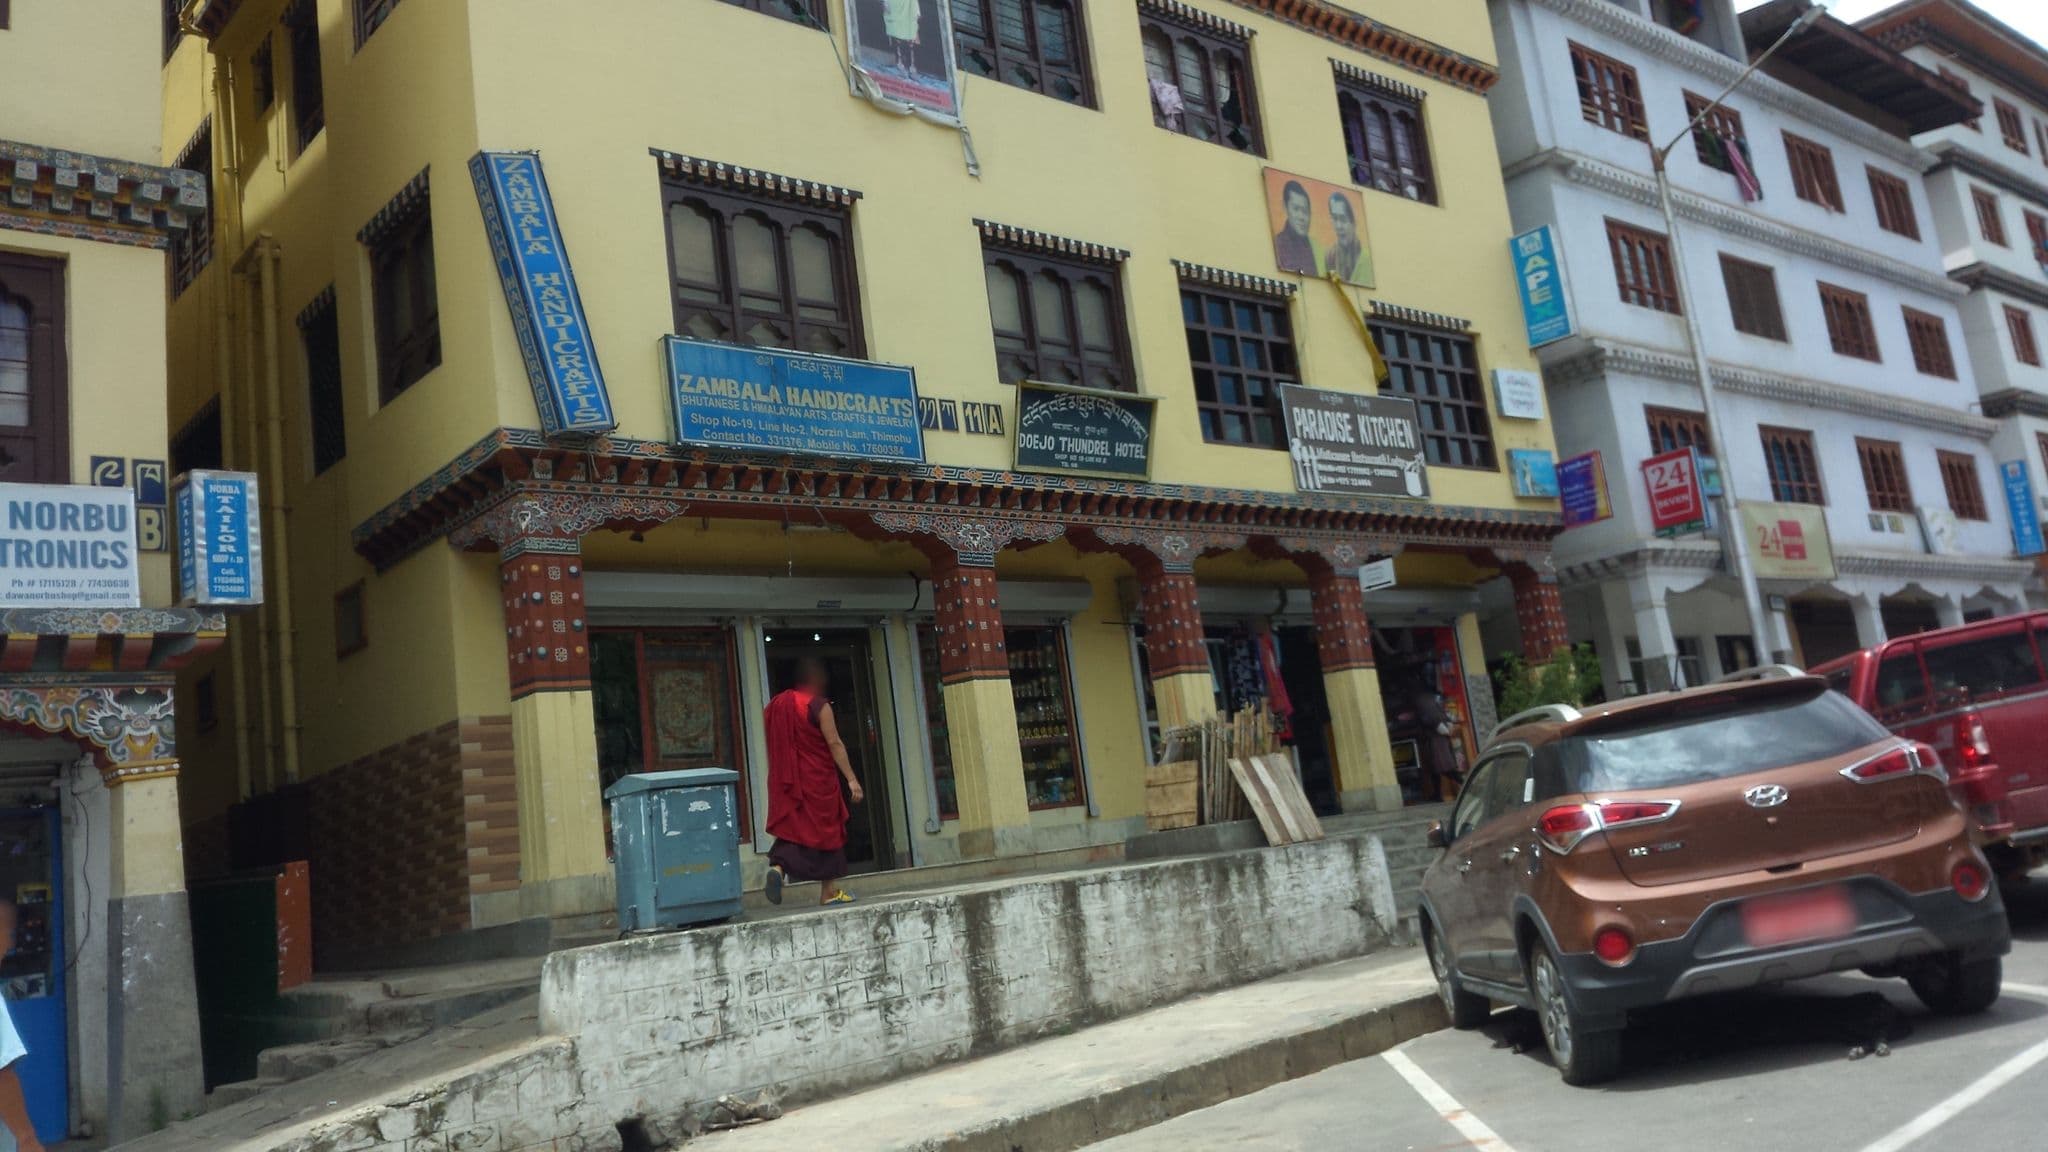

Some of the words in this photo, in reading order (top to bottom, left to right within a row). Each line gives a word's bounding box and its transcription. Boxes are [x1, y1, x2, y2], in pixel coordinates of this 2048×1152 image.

[500, 159, 551, 255] ZAMBALA
[533, 272, 602, 425] HANDICRAFTS
[1523, 255, 1558, 321] APEX
[680, 374, 783, 404] ZAMBALA
[786, 386, 913, 418] HANDICRAFTS
[682, 395, 740, 411] BHUTANESE
[752, 402, 801, 418] HIMALAYAN
[831, 411, 866, 424] CRAFTS
[877, 417, 914, 429] JEWELRY
[690, 412, 720, 429] Shop
[758, 420, 780, 432] Line
[811, 425, 843, 438] Norzin
[871, 430, 912, 445] Thimphu
[703, 428, 744, 442] Contact
[808, 439, 838, 450] Mobile
[1292, 406, 1354, 443] PARADISE
[1357, 413, 1415, 449] KITCHEN
[1019, 433, 1055, 450] DOEJO
[1059, 437, 1111, 456] THUNDREL
[1115, 442, 1146, 459] HOTEL
[1651, 461, 1687, 489] 24
[8, 500, 127, 532] NORBU
[216, 495, 237, 553] TAILOR
[0, 538, 129, 569] TRONICS
[1757, 525, 1781, 552] 24
